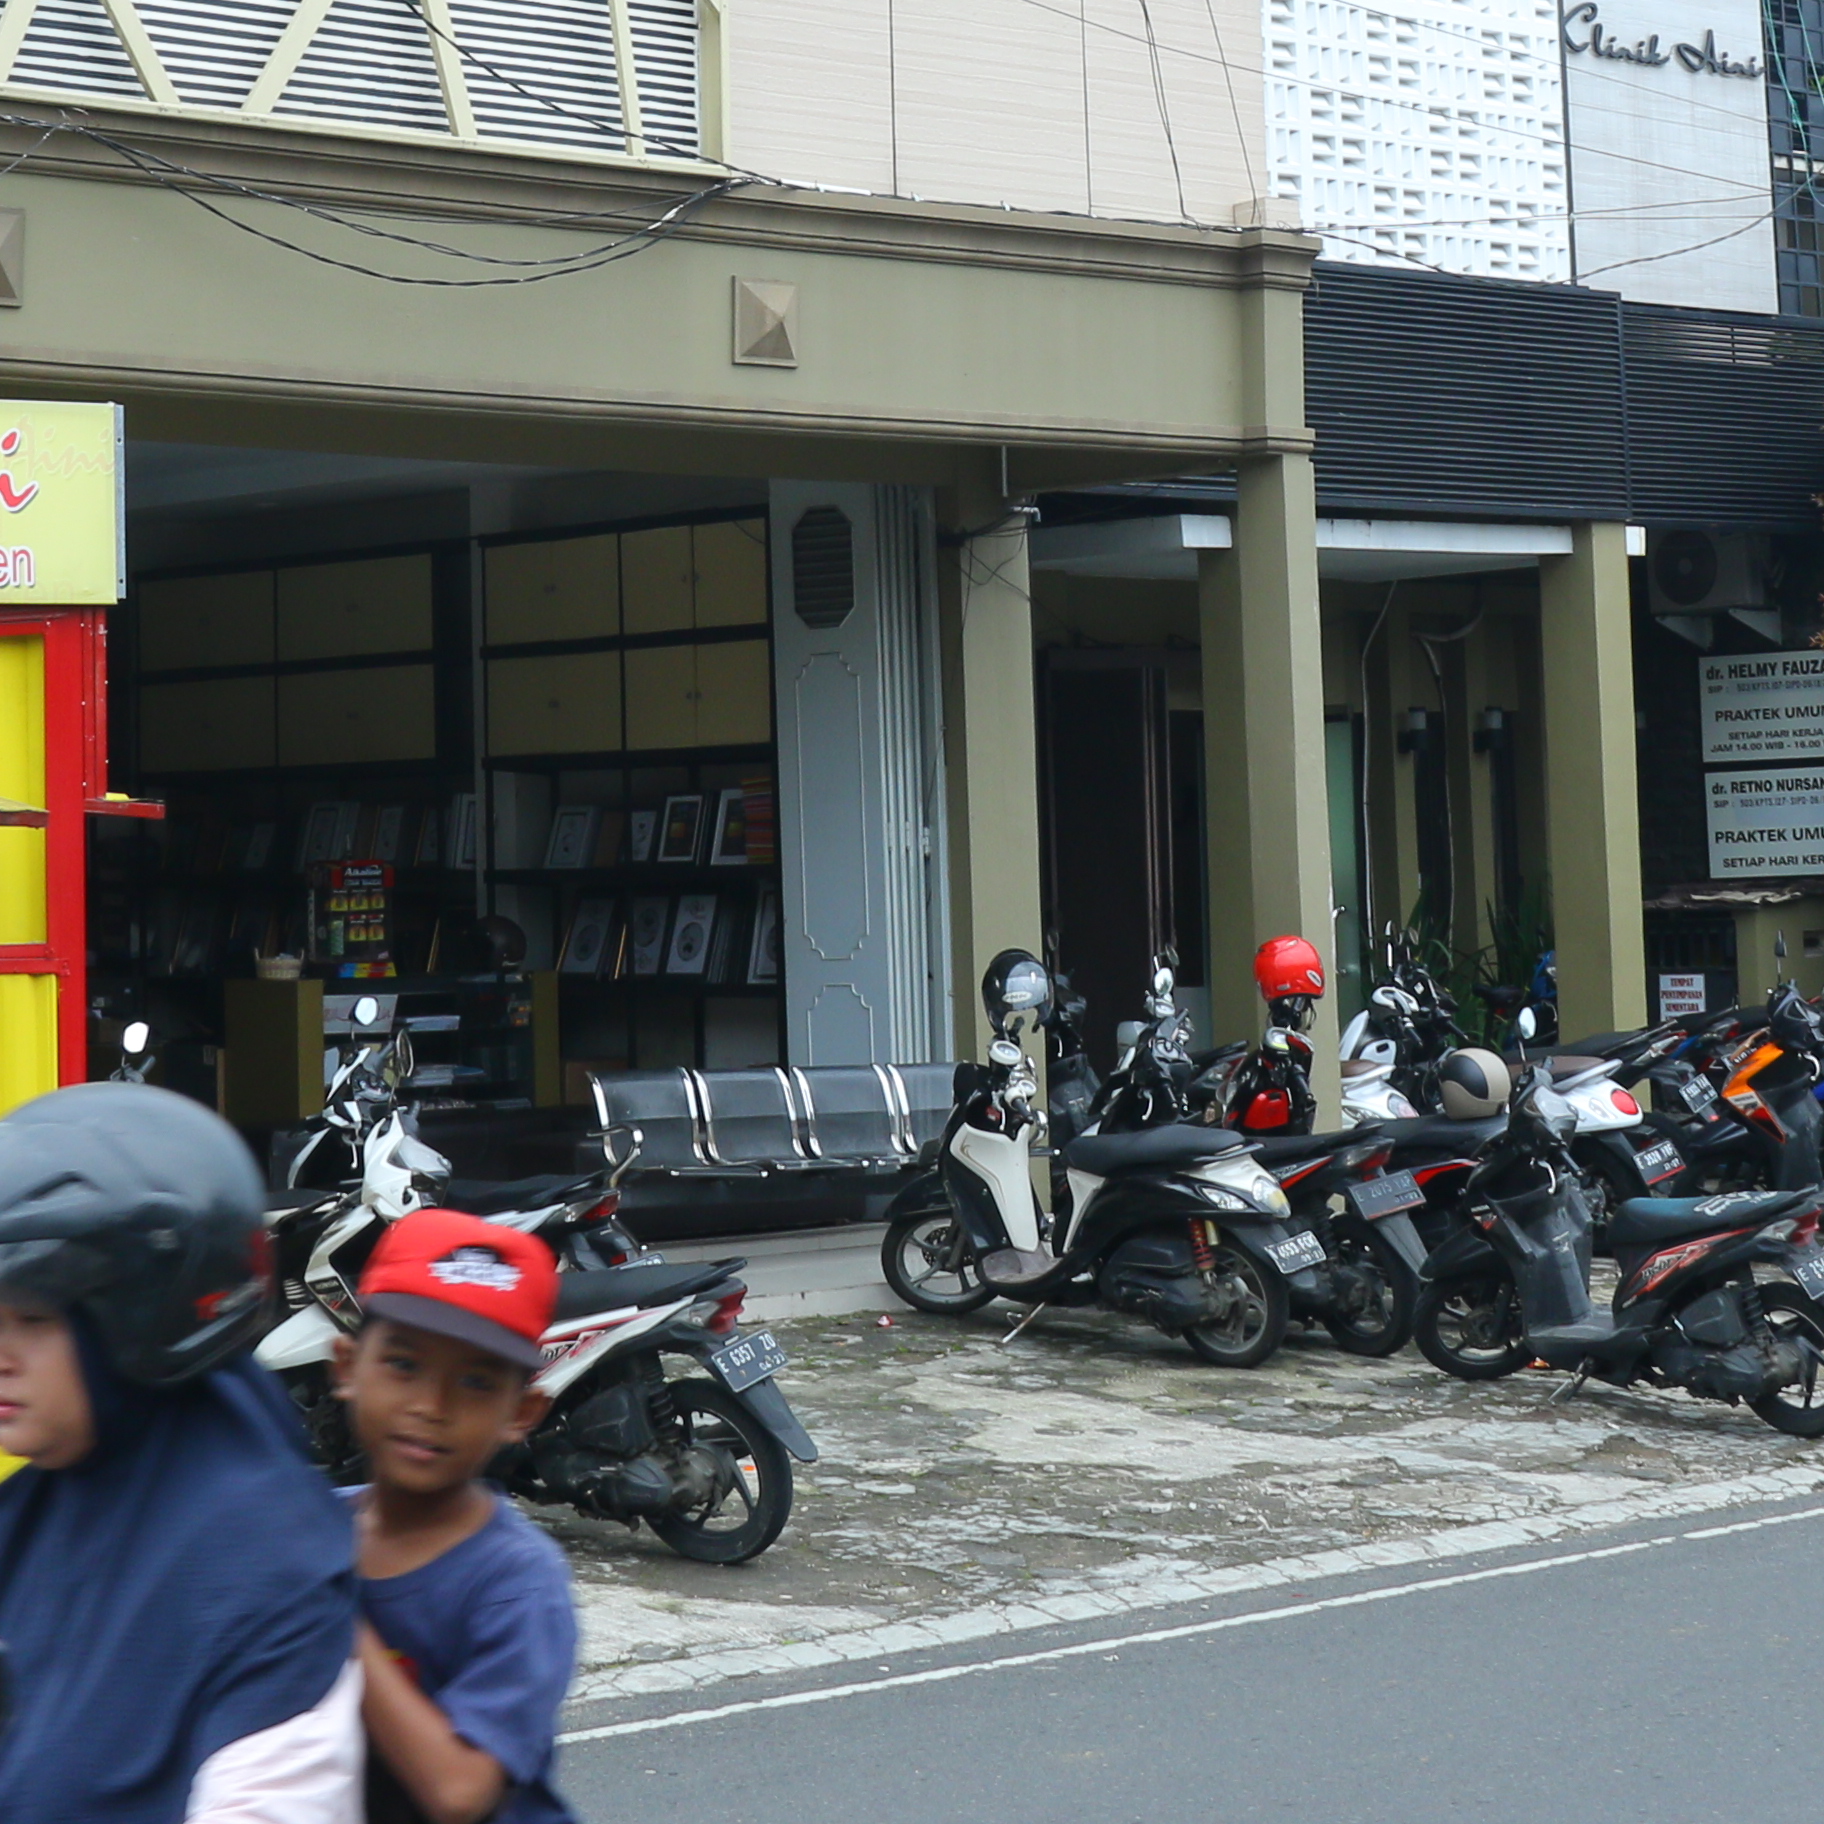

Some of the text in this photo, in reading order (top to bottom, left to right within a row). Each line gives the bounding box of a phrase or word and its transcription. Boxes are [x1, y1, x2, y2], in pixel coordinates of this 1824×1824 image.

[1675, 29, 1765, 77] Aini
[1706, 666, 1724, 680] dr.
[1728, 662, 1777, 678] HELMY
[1715, 708, 1780, 722] PRAKTEK
[1728, 728, 1824, 740] SETIAP HARI KERJA
[1710, 744, 1733, 753] JAM
[1764, 741, 1784, 750] WIB
[1711, 783, 1727, 795] dr.
[1731, 780, 1773, 794] RETNO
[1715, 829, 1788, 844] PRAKTEK
[1723, 857, 1765, 868] SETIAP
[1769, 855, 1798, 866] HARI
[717, 1357, 730, 1373] E
[729, 1343, 756, 1366] 6357
